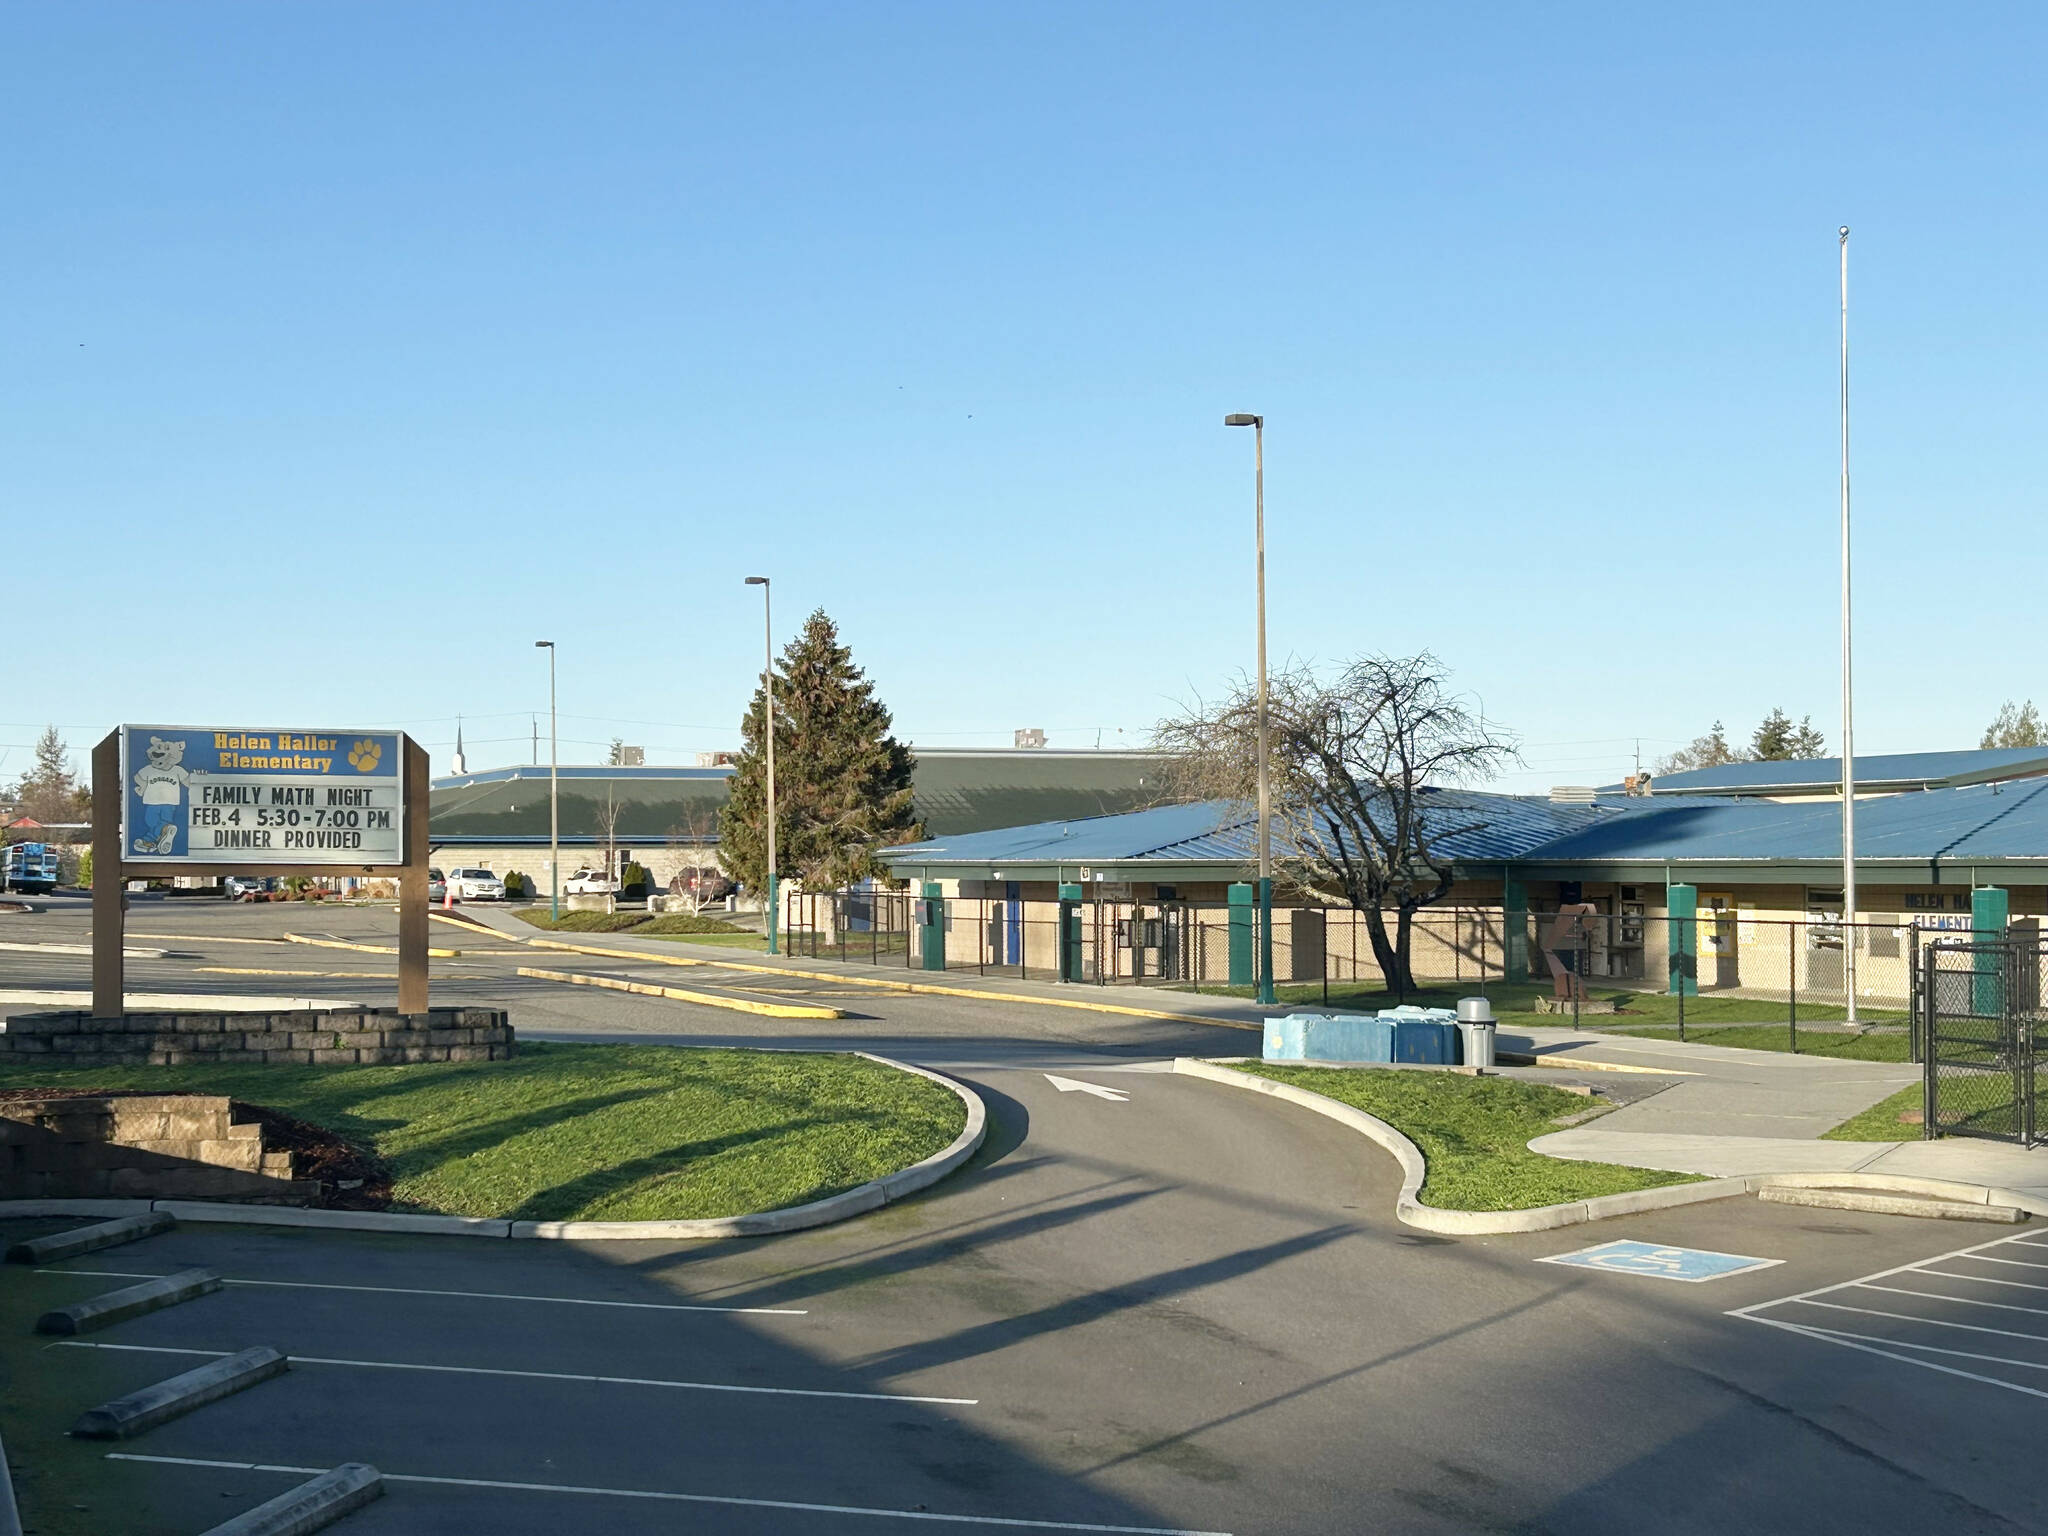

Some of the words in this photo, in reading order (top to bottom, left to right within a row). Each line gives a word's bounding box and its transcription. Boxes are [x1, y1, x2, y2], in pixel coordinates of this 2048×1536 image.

[214, 733, 271, 750] Helen
[278, 734, 337, 751] Haller
[219, 752, 333, 774] Elementary
[203, 786, 261, 805] FAMILY
[271, 787, 314, 806] MATH
[327, 788, 373, 806] NIGHT
[367, 810, 390, 828] PM
[214, 829, 271, 848] DINNER
[284, 830, 361, 849] PROVIDED
[1913, 915, 1972, 930] ELEMENT
